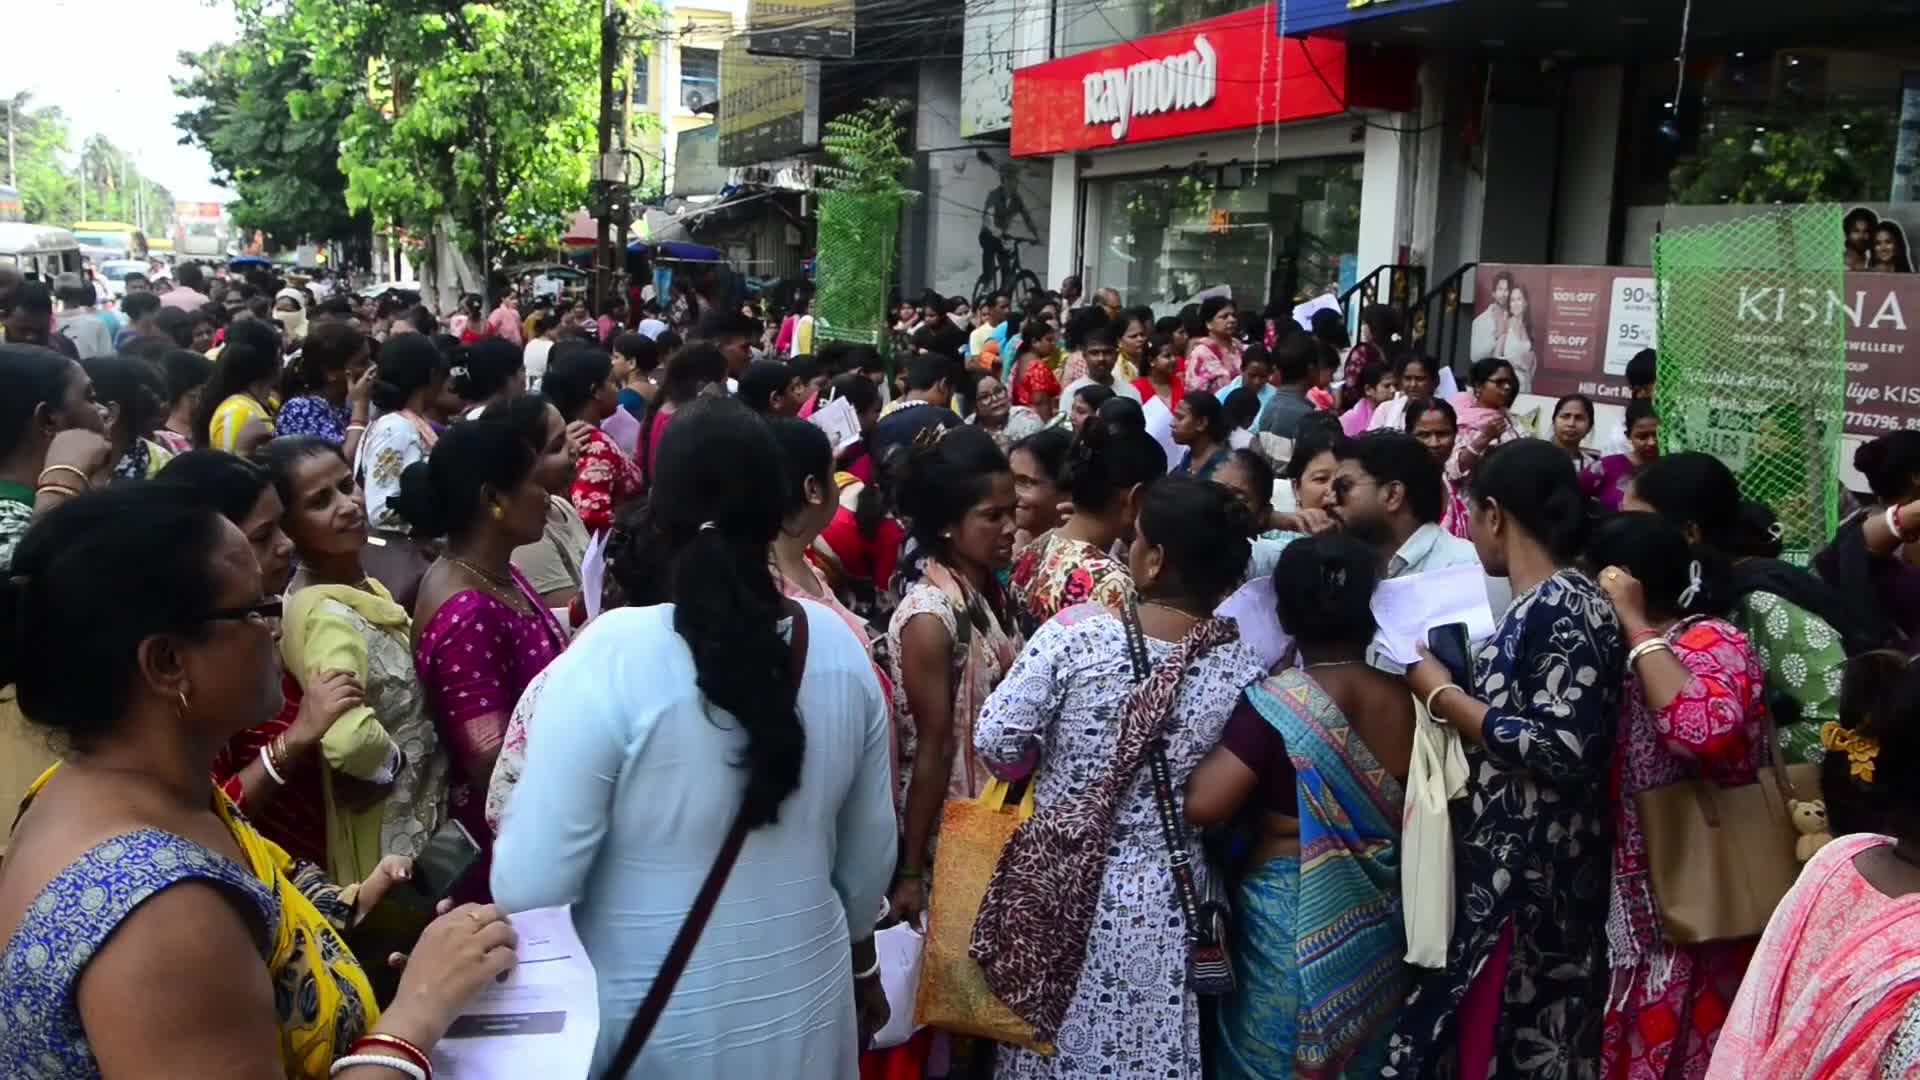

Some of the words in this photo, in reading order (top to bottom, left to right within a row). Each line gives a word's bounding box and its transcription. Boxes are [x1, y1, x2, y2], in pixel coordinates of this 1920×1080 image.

[1082, 33, 1217, 140] Raymond
[1736, 286, 1908, 330] KISNA
[1597, 383, 1620, 397] Cart
[1845, 381, 1881, 405] liye
[1883, 384, 1920, 404] KIS
